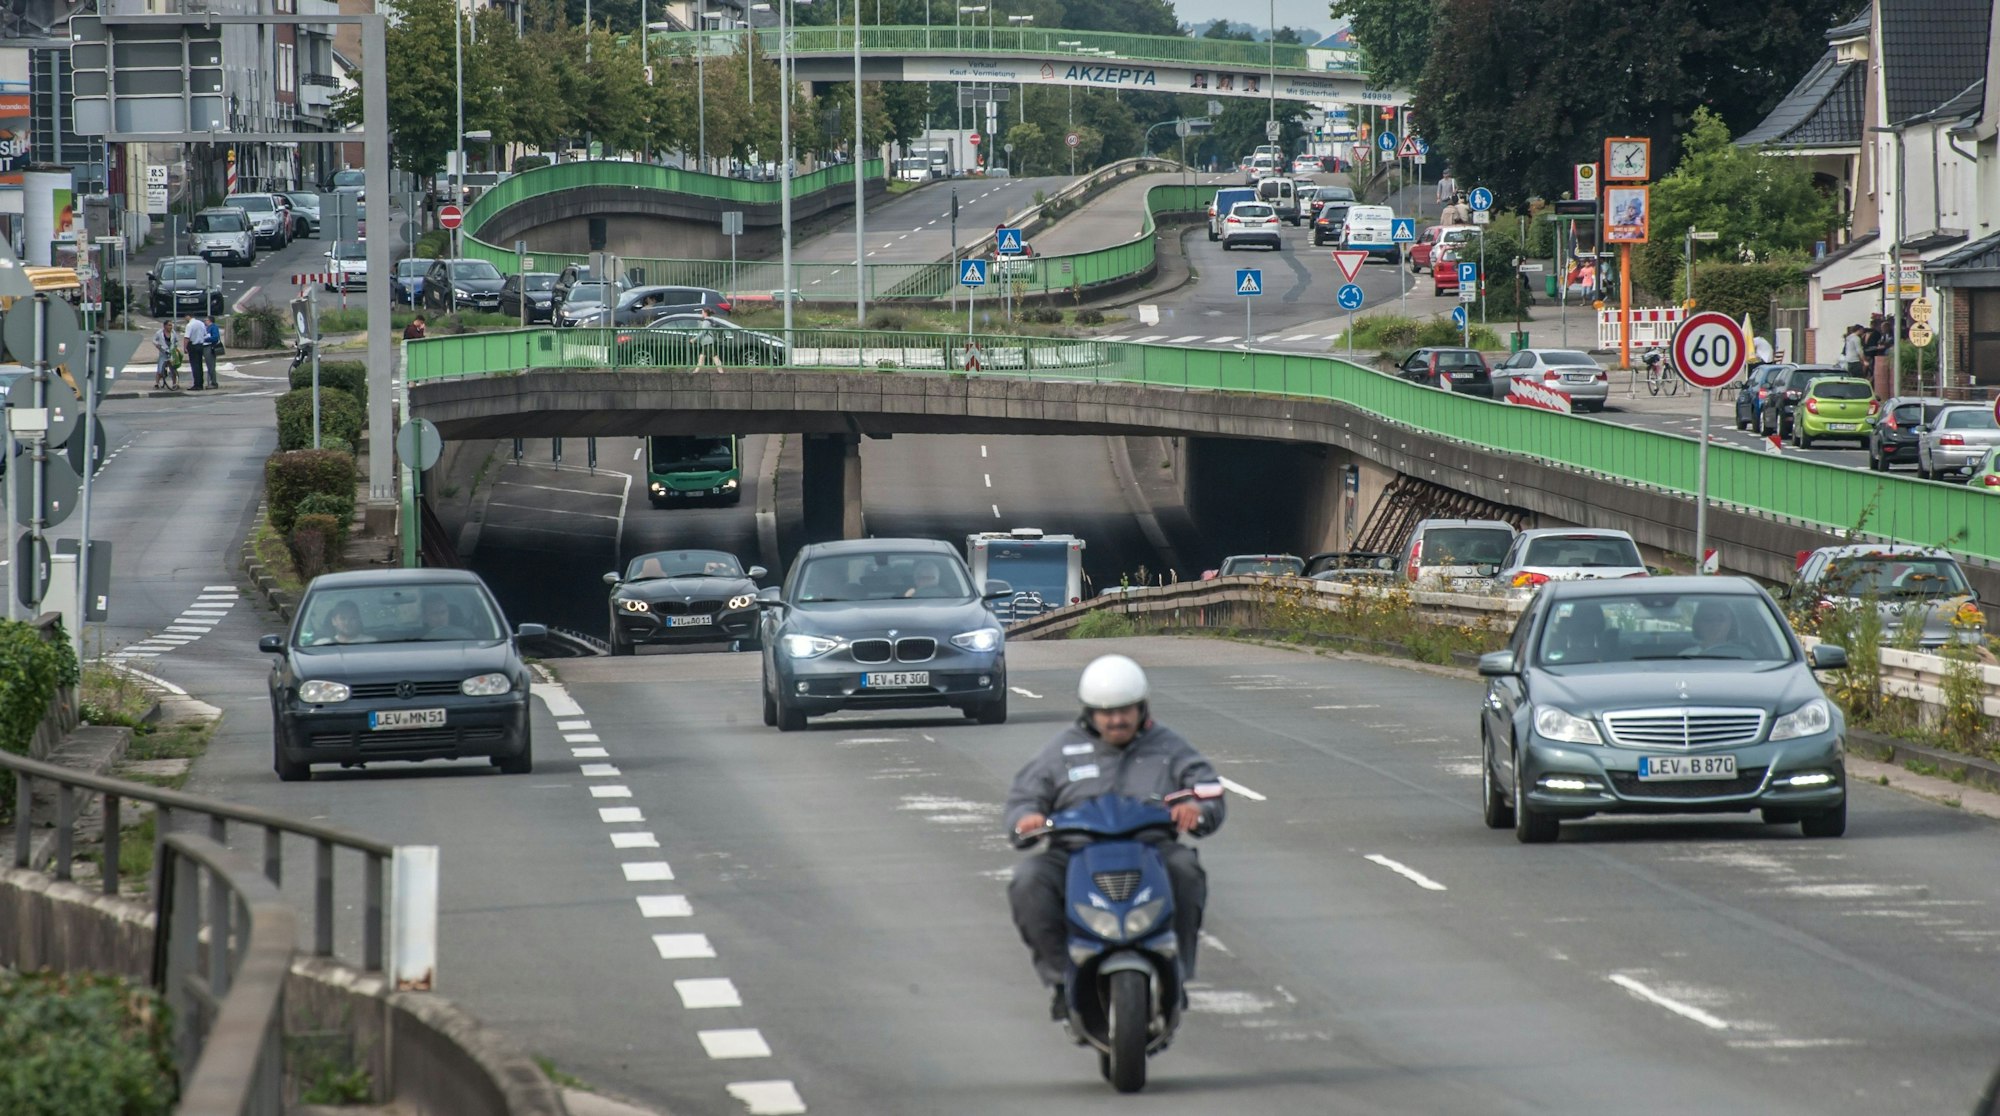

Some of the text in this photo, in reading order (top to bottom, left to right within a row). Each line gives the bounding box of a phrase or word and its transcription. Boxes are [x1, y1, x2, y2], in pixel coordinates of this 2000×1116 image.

[968, 61, 998, 69] Verkauf
[973, 69, 1016, 79] Vermietung
[1065, 65, 1156, 86] AKZEPTA
[1362, 92, 1392, 101] 949898
[1462, 265, 1473, 280] P
[1889, 271, 1919, 280] KOSK
[1691, 334, 1730, 367] 60
[867, 673, 928, 686] LEV ER 300
[377, 710, 444, 726] LEV MN 51
[1649, 758, 1734, 775] LEV B 870
